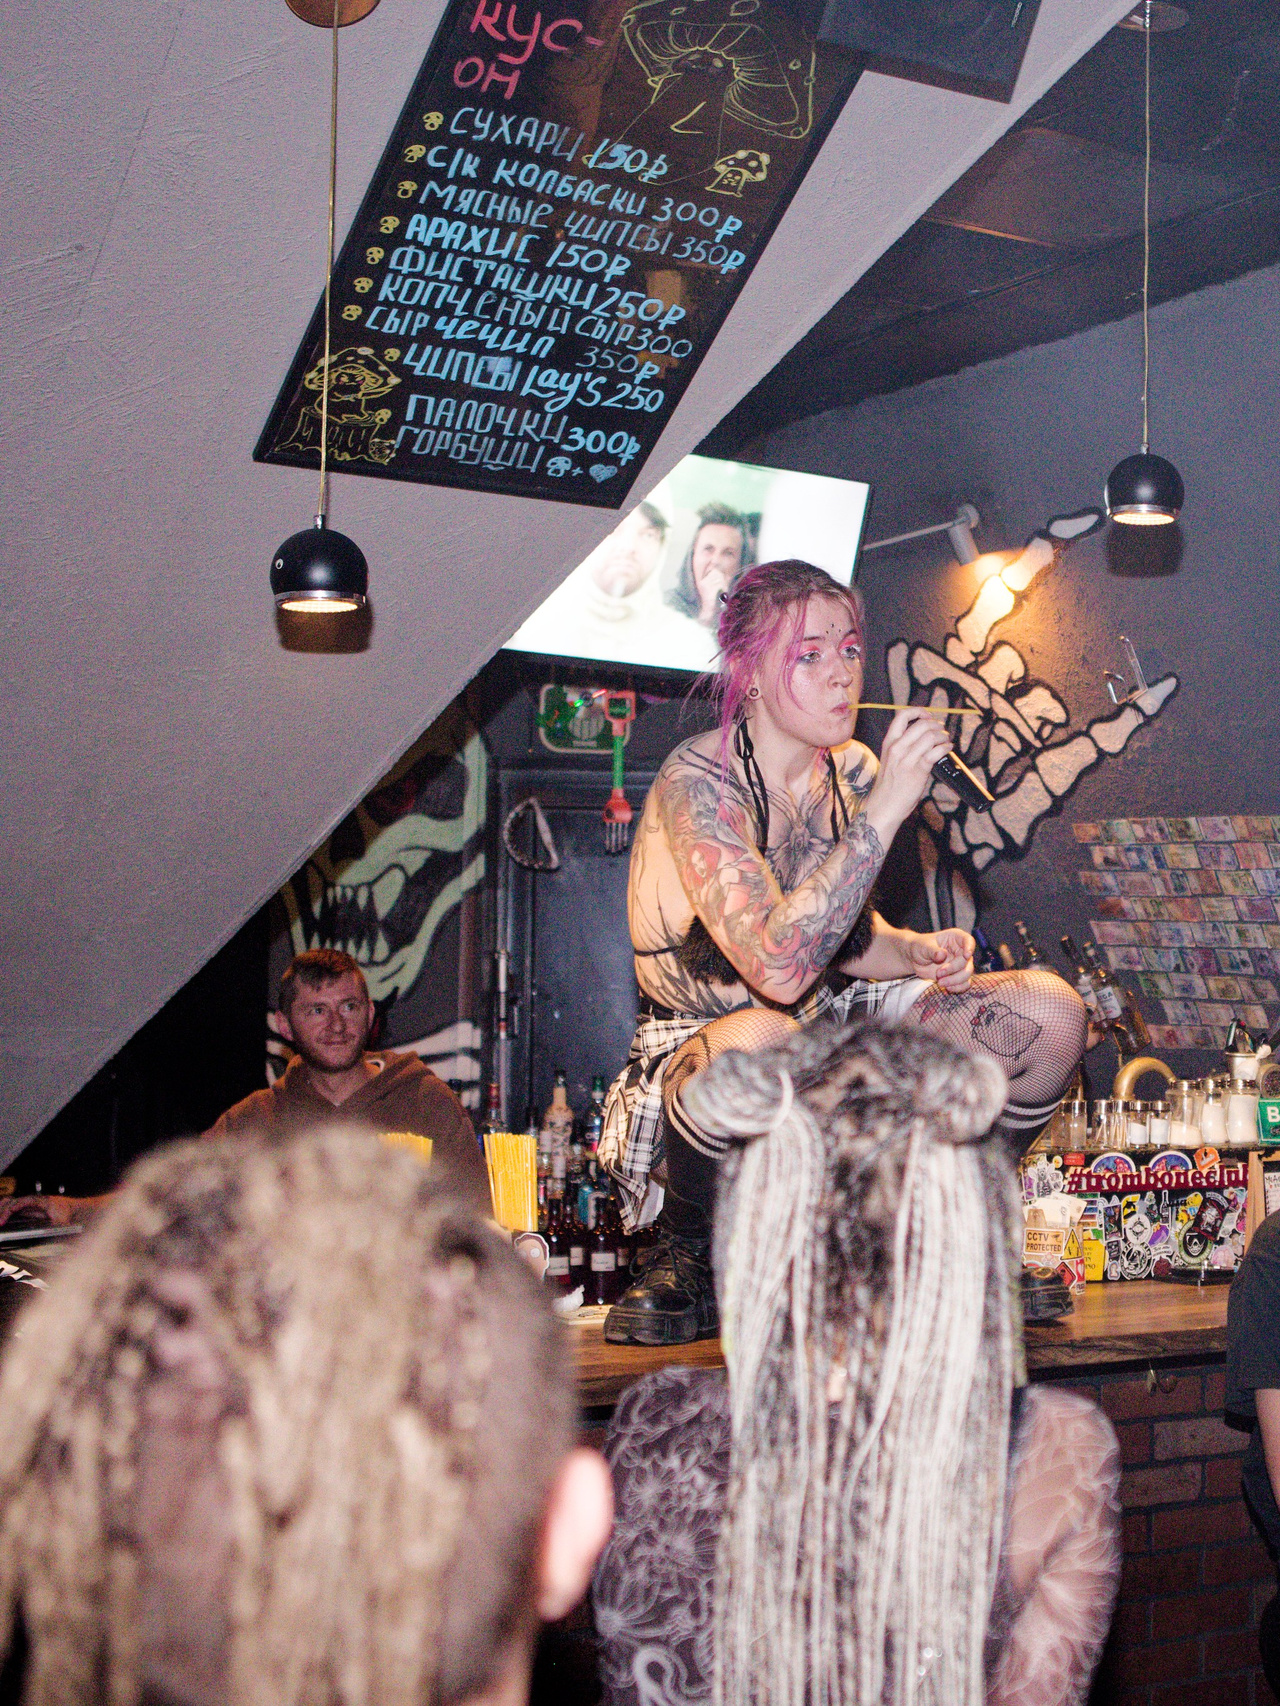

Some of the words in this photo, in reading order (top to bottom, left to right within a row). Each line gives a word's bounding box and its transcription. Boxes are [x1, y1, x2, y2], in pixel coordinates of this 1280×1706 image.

[453, 56, 521, 99] ОН
[450, 107, 585, 162] СУХАРИ
[492, 158, 647, 216] КОЛБАСКИ
[405, 213, 541, 264] АРАХИС
[564, 210, 674, 255] ЧИПСЫ
[388, 244, 599, 310] ФИСТАШКИ
[365, 306, 430, 337] СЫР
[574, 315, 636, 346] СЫР
[625, 327, 693, 358] 300
[403, 343, 523, 392] ЧИПСЫ
[600, 382, 665, 412] 250
[405, 394, 569, 443] ПАЛОЧКИ
[394, 425, 545, 473] ГОРБУШИ
[1026, 1231, 1050, 1241] CCTV
[1026, 1243, 1062, 1252] PROTECTED
